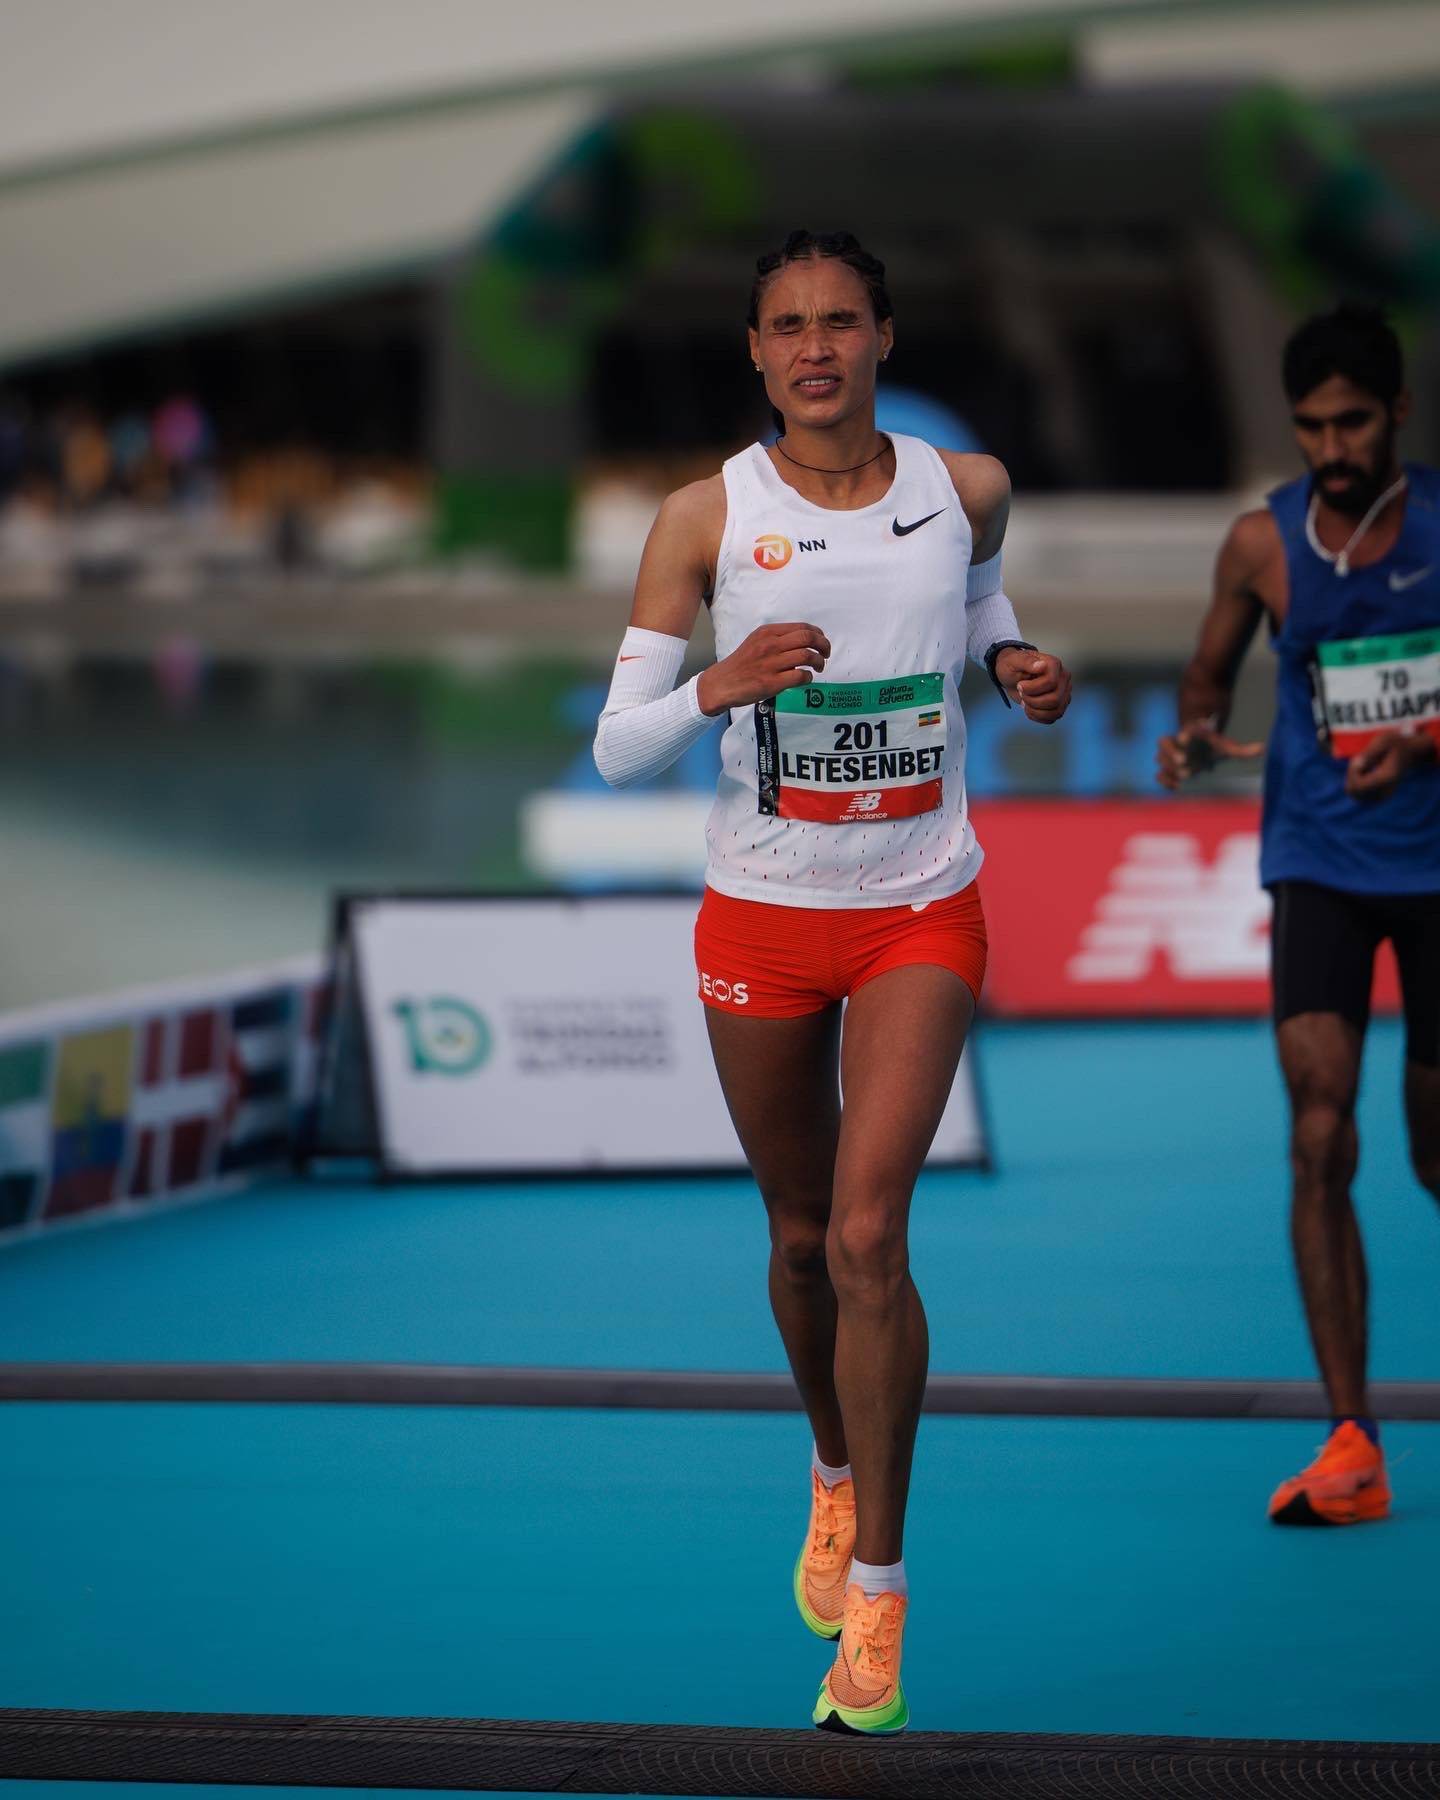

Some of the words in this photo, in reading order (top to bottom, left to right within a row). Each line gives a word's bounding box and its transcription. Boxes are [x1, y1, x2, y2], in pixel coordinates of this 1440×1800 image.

[798, 539, 826, 552] NN
[1376, 667, 1409, 693] 70
[828, 695, 862, 703] TRINIDAD
[834, 720, 887, 751] 201
[782, 745, 944, 783] LETESENBET
[856, 812, 888, 820] balance
